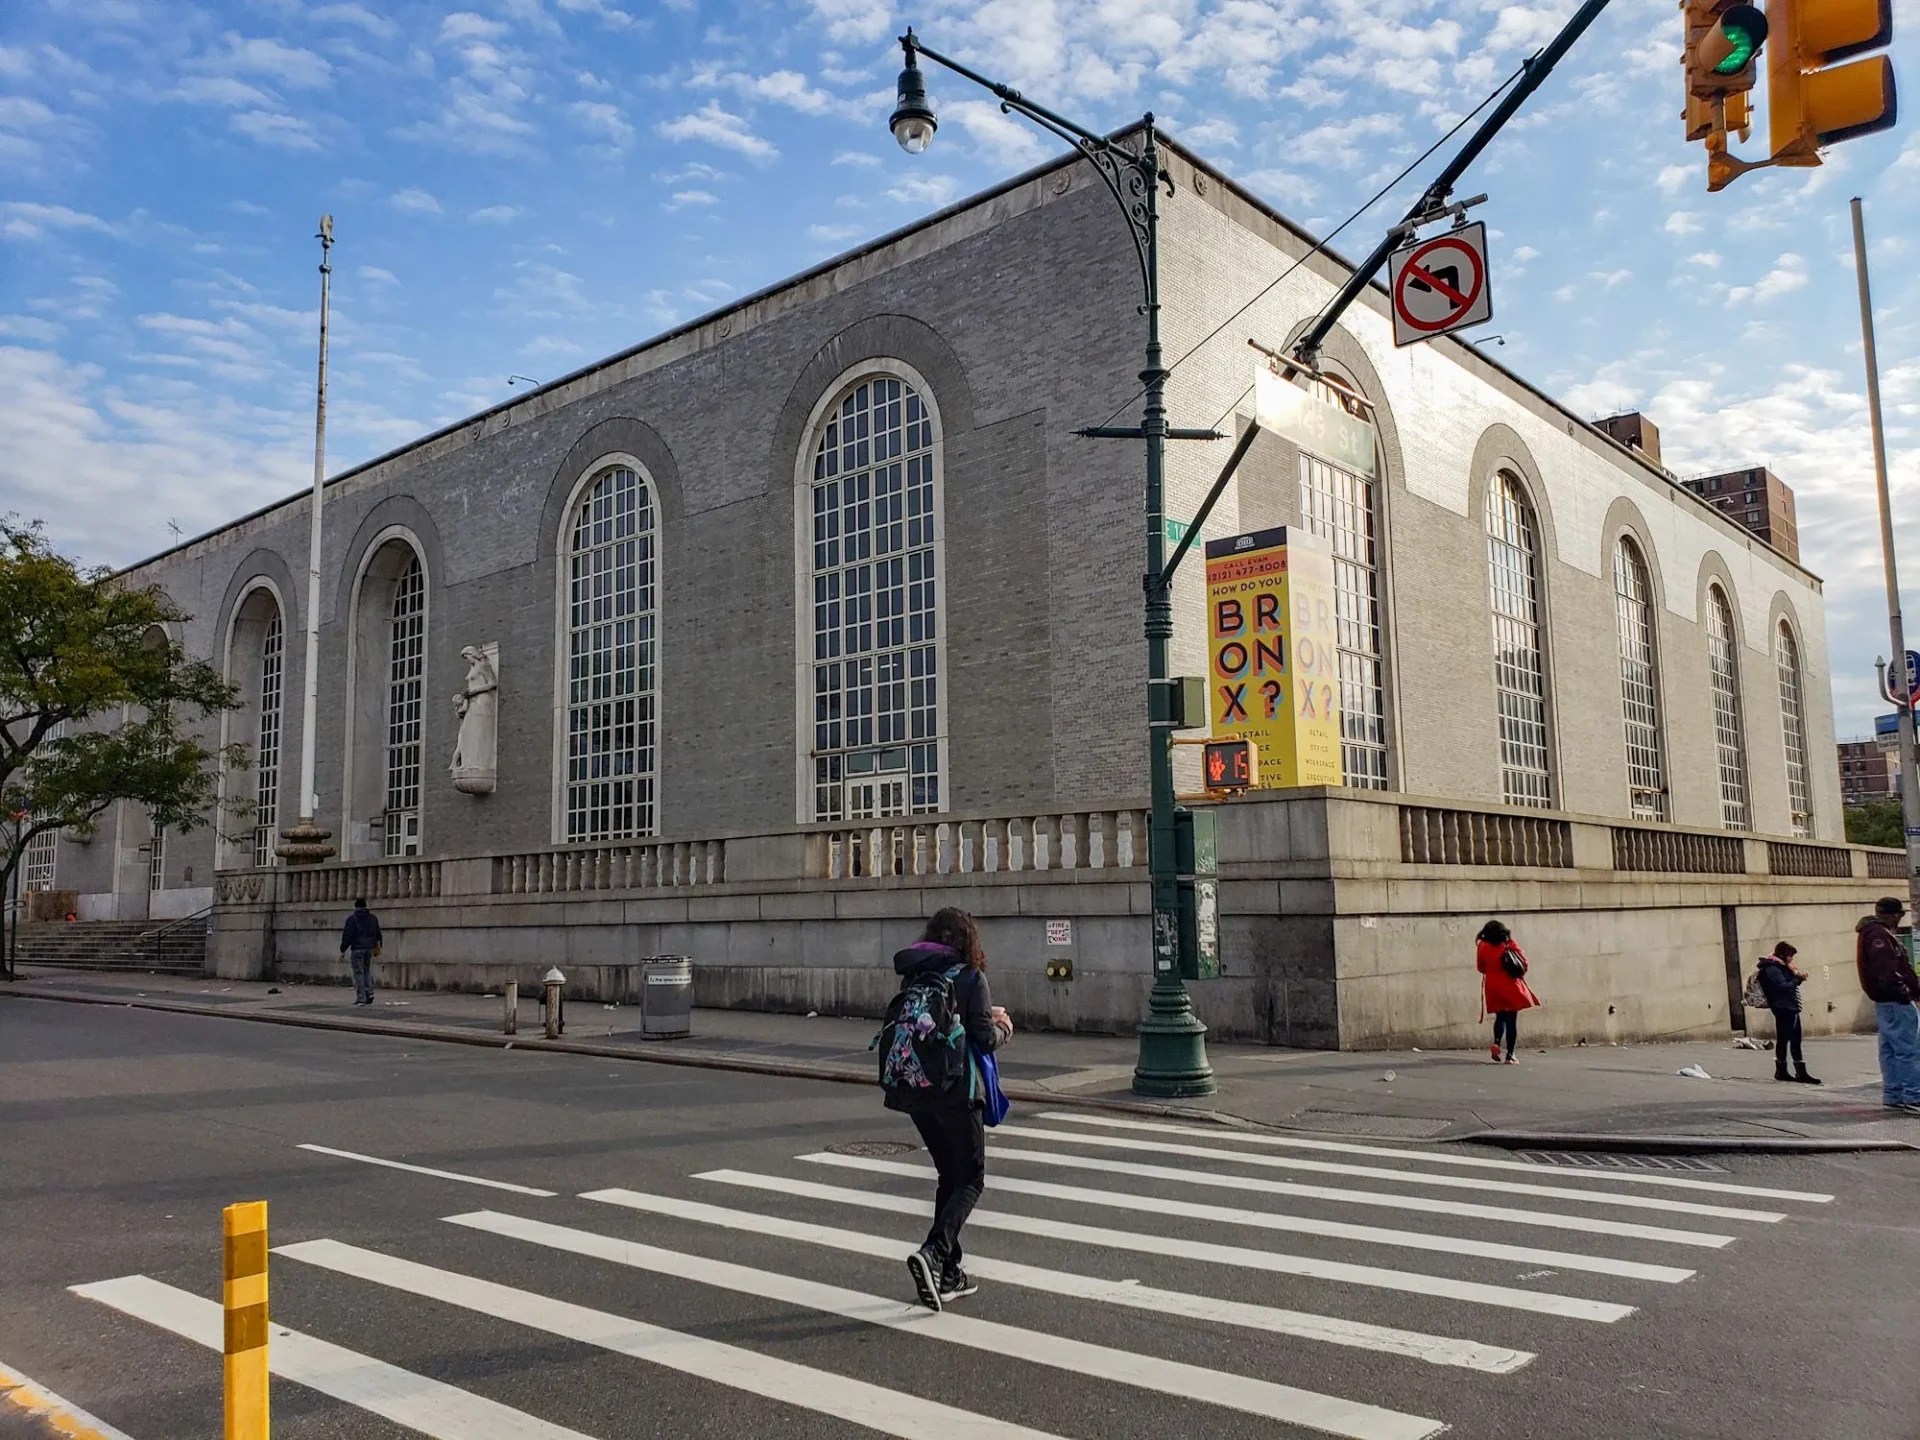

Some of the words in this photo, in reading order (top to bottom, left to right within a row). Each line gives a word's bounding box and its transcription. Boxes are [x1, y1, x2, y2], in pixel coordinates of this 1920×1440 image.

[1338, 425, 1359, 455] St
[1208, 570, 1232, 581] (212)
[1224, 561, 1244, 569] CALL
[1248, 556, 1268, 565] EVAN
[1213, 584, 1237, 597] HOW
[1241, 581, 1256, 591] DO
[1258, 576, 1282, 588] YOU
[1216, 594, 1281, 636] BR
[1216, 635, 1284, 678] ON
[1234, 750, 1248, 779] 15
